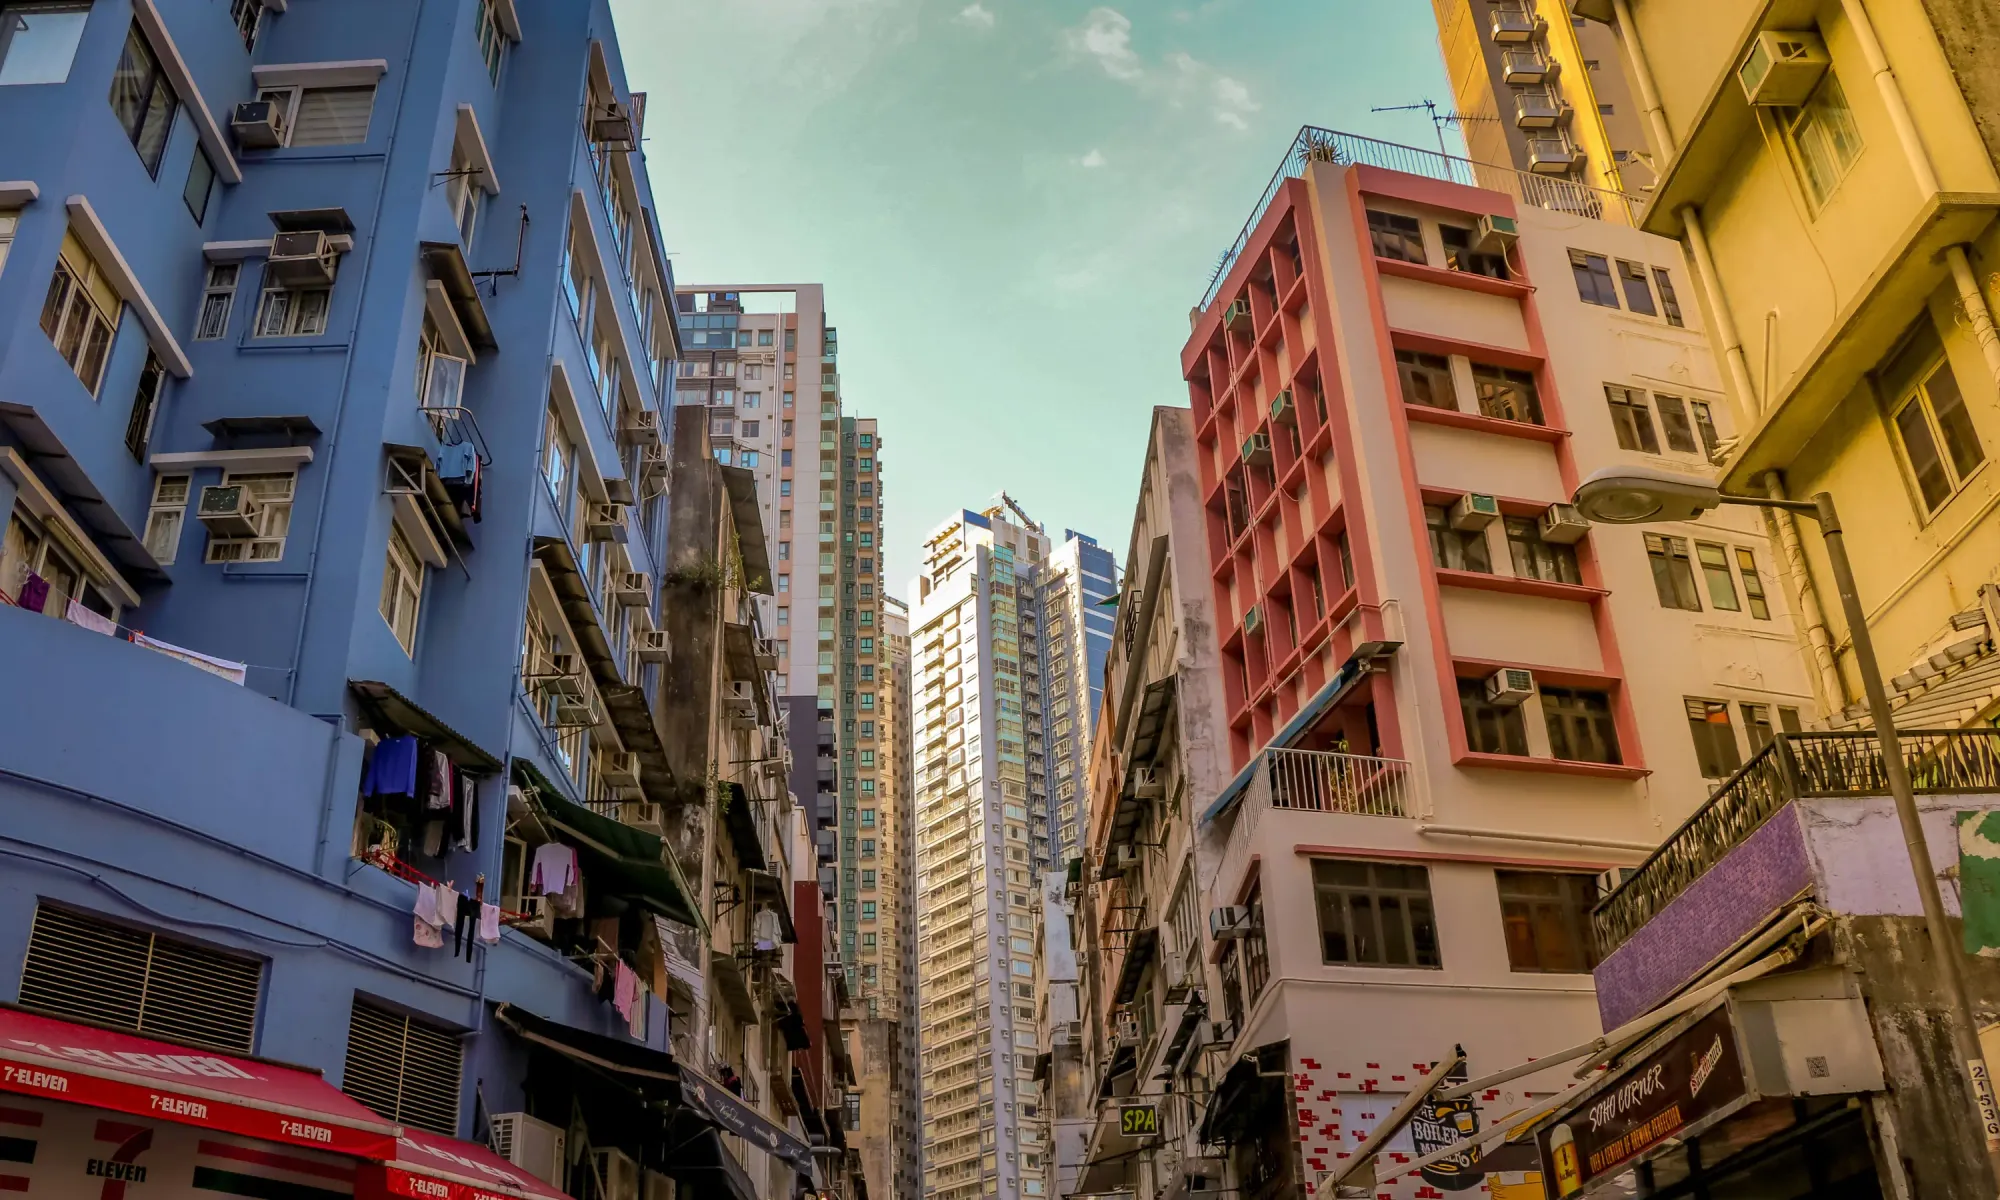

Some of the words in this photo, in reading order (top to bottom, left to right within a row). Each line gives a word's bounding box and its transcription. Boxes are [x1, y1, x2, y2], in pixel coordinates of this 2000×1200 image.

[4, 1066, 68, 1093] 7-ELEVEN
[150, 1094, 208, 1119] 7-ELEVEN
[1589, 1094, 1616, 1133] SOHO
[1618, 1064, 1665, 1113] CORNER
[1973, 1066, 1999, 1134] 21536
[280, 1120, 332, 1143] 7-ELEVEN
[1123, 1109, 1155, 1132] SPA
[1413, 1121, 1459, 1145] BOILER
[86, 1159, 146, 1183] ELEVEN
[409, 1177, 449, 1199] 7-ELEVEN
